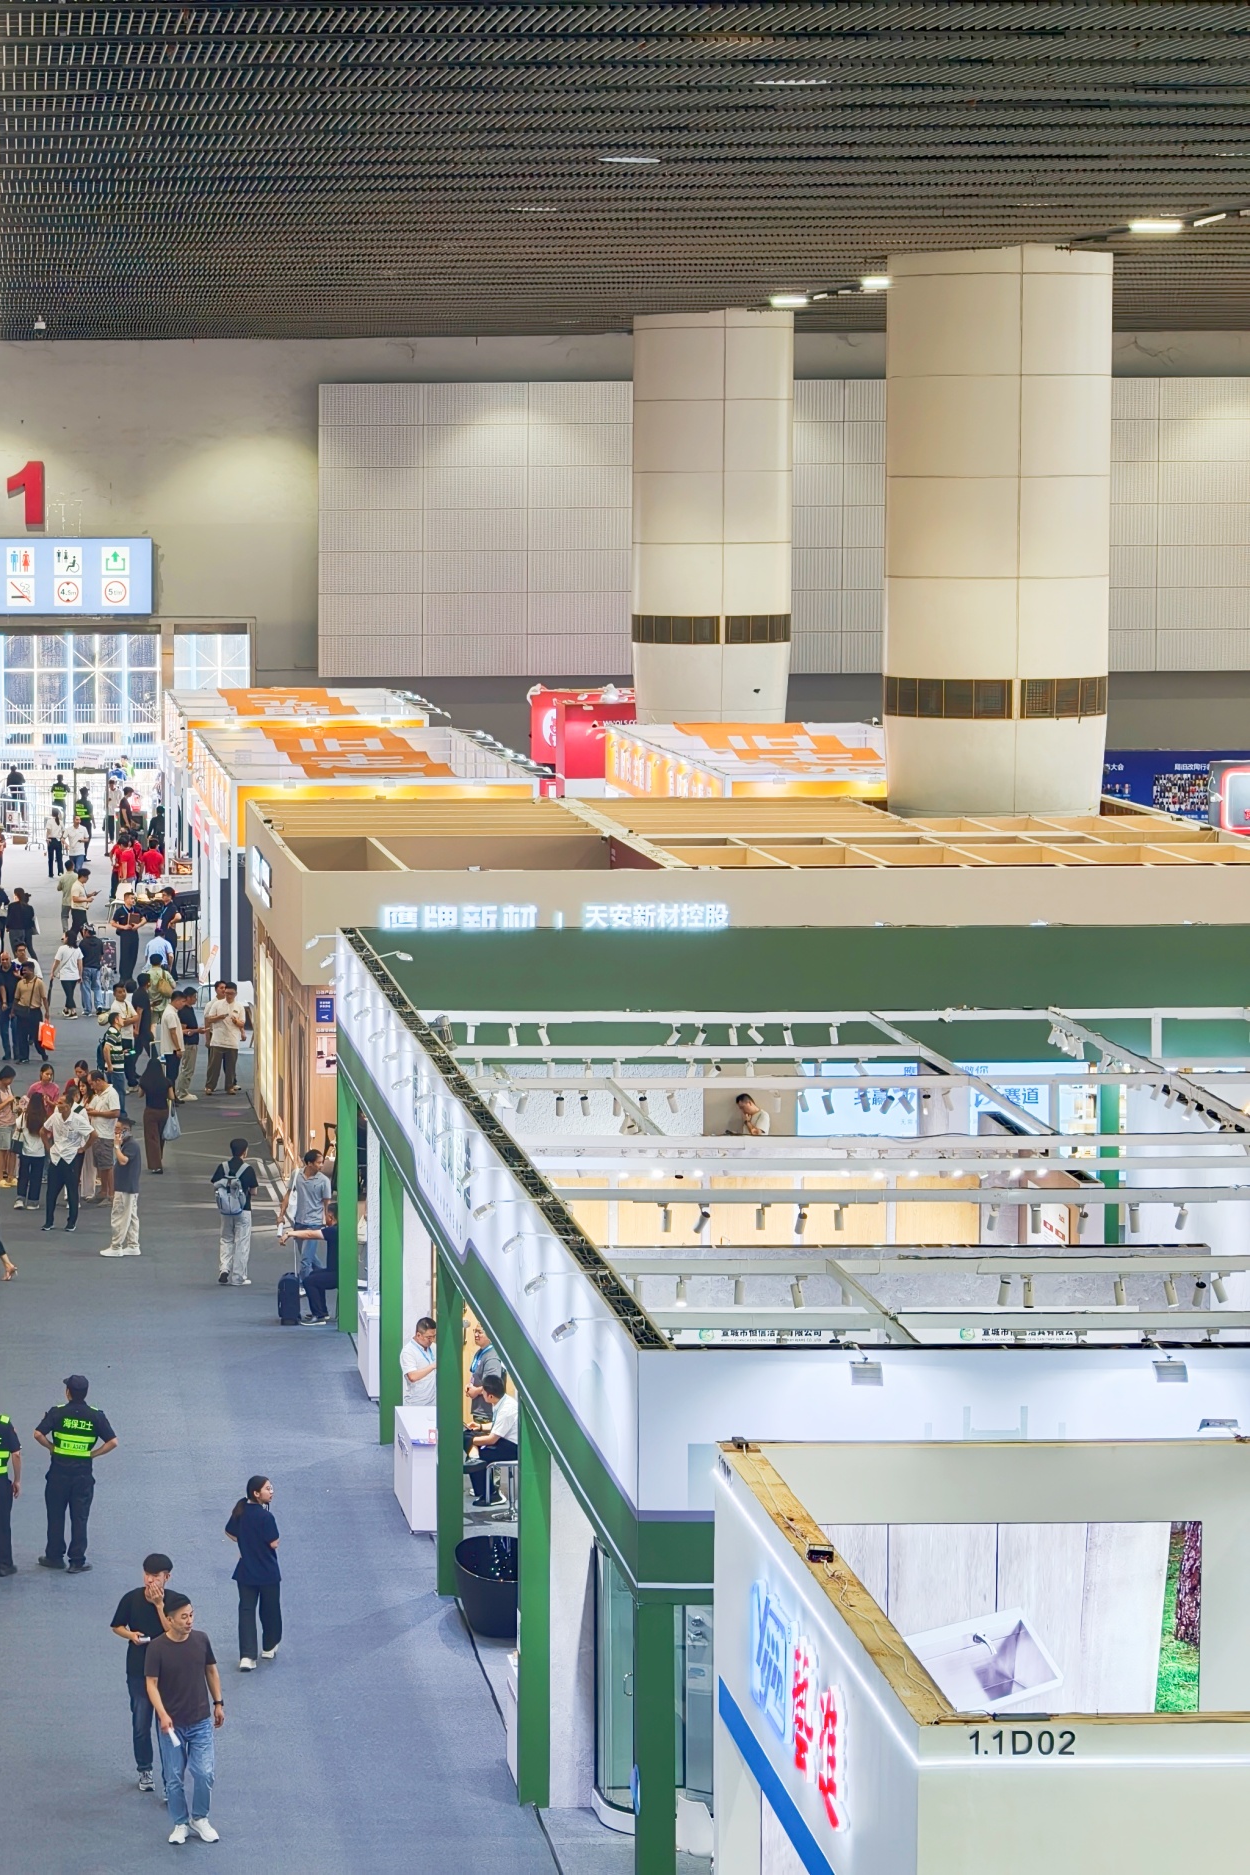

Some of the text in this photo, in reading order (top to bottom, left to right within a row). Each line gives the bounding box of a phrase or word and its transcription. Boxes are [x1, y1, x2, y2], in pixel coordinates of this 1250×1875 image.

[384, 904, 730, 929] 鹰牌新材 天安新材控股
[969, 1730, 1076, 1755] 1.1D02
